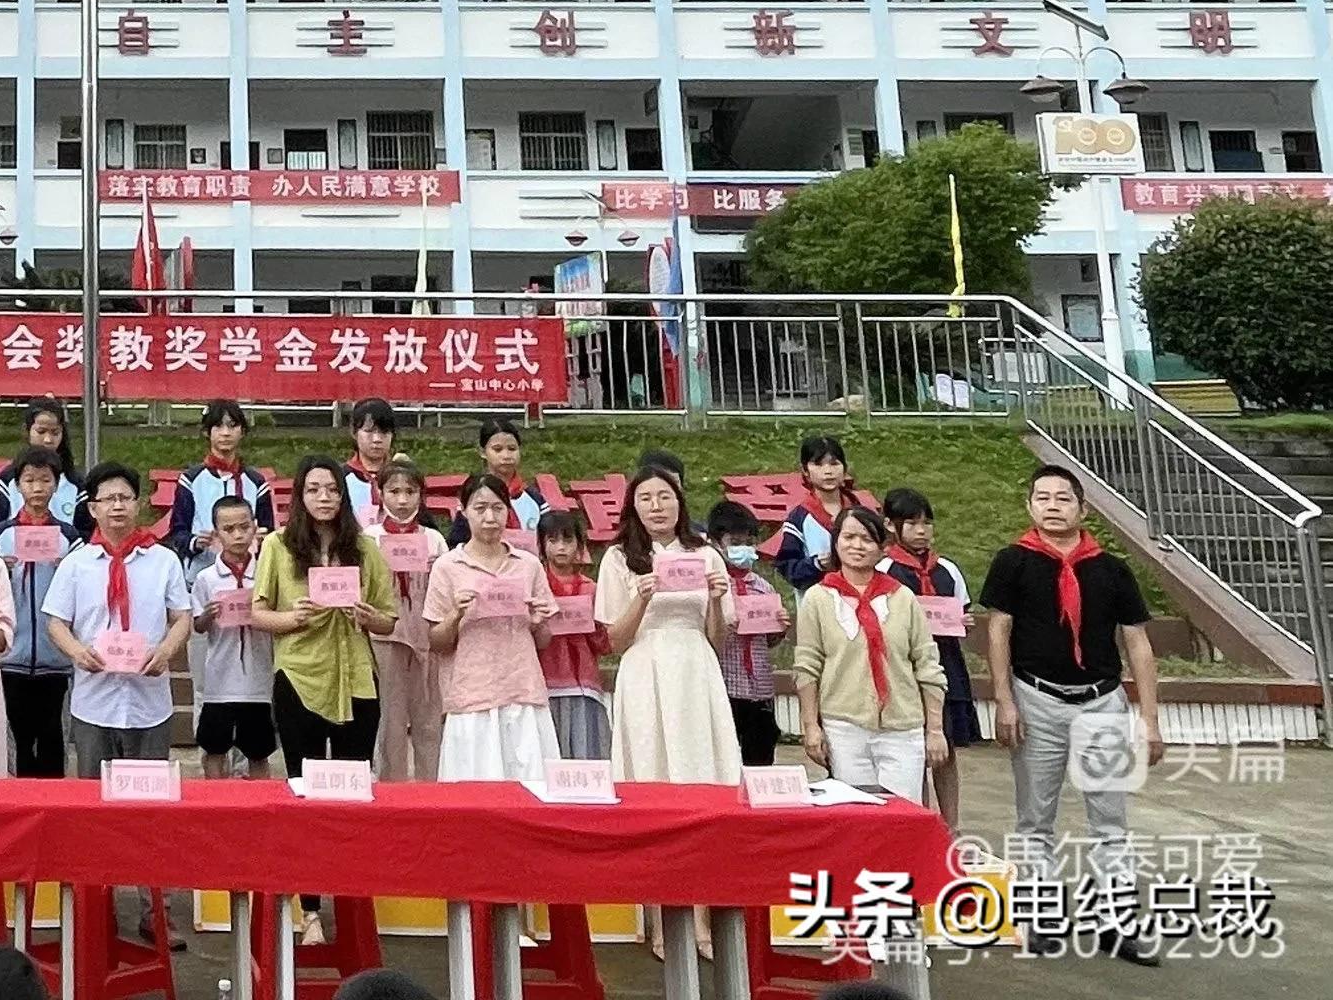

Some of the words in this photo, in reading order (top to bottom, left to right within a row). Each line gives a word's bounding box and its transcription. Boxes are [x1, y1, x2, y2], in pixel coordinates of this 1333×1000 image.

[117, 9, 149, 56] 自
[327, 10, 368, 56] 主
[534, 9, 576, 56] 创
[752, 10, 796, 56] 新
[969, 11, 1015, 57] 文
[1190, 11, 1233, 55] 明
[615, 187, 690, 211] 比学习
